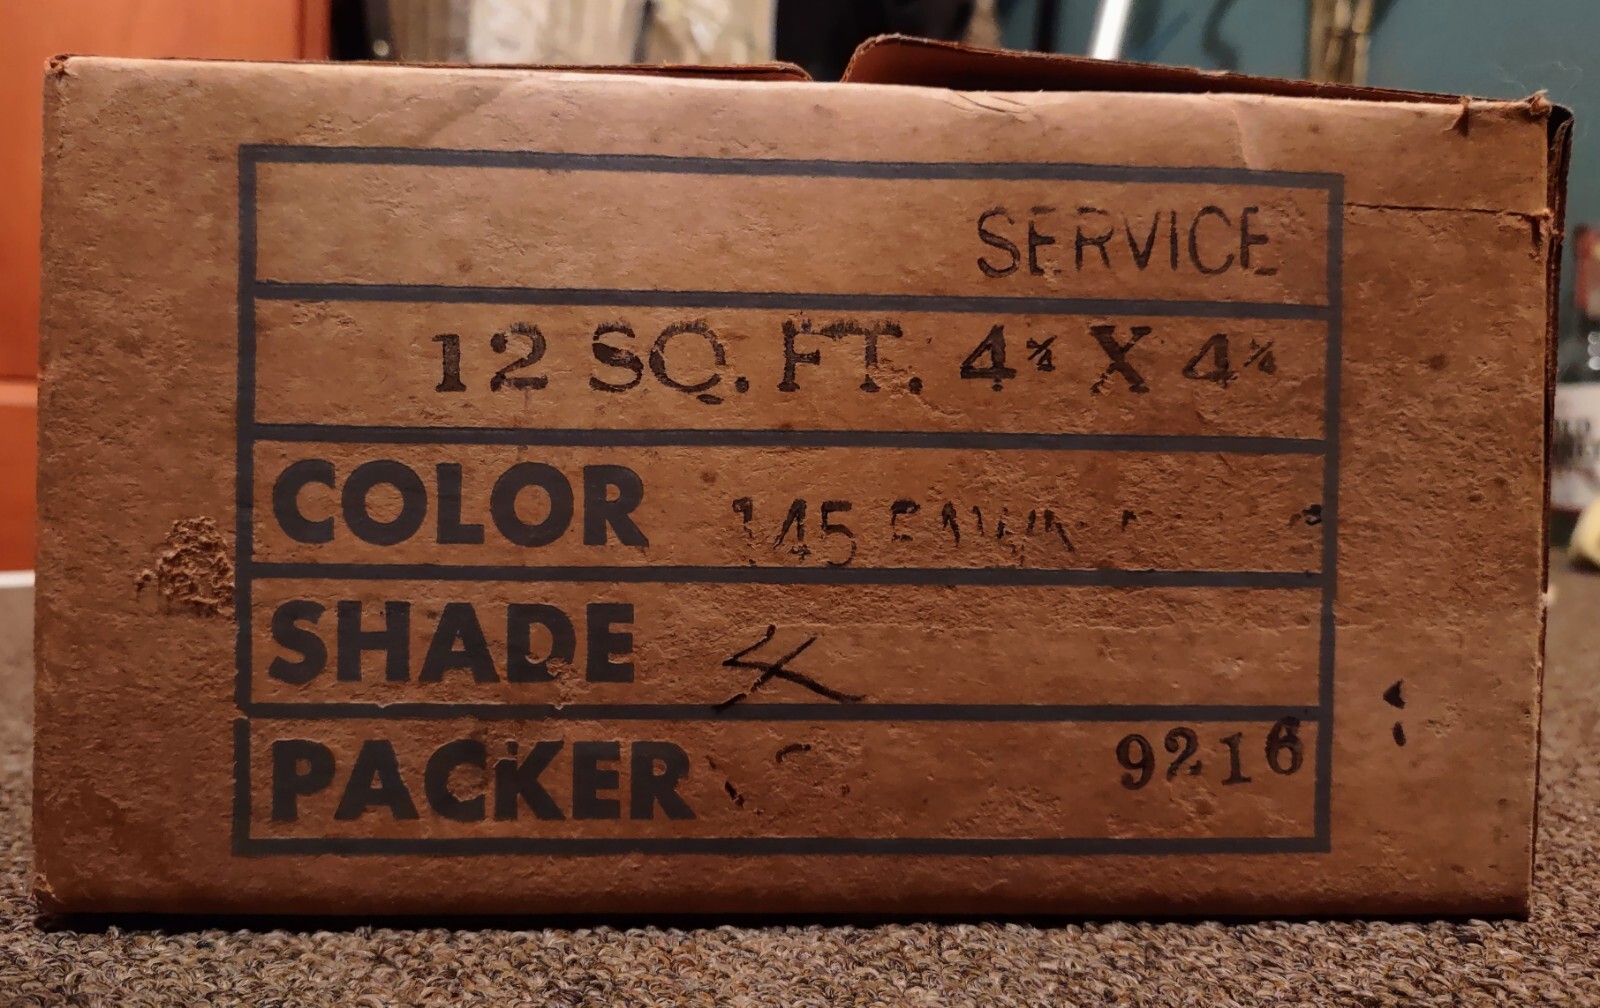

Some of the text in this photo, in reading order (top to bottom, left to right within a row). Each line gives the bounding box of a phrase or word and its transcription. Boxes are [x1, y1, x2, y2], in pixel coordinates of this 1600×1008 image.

[977, 205, 1278, 278] SERVICE
[432, 321, 549, 393] 12
[588, 320, 752, 405] SQ.
[777, 318, 923, 394] FT.
[272, 458, 650, 547] COLOR
[268, 599, 634, 685] SHADE
[271, 738, 697, 822] PACKER
[1115, 716, 1304, 790] 9216
